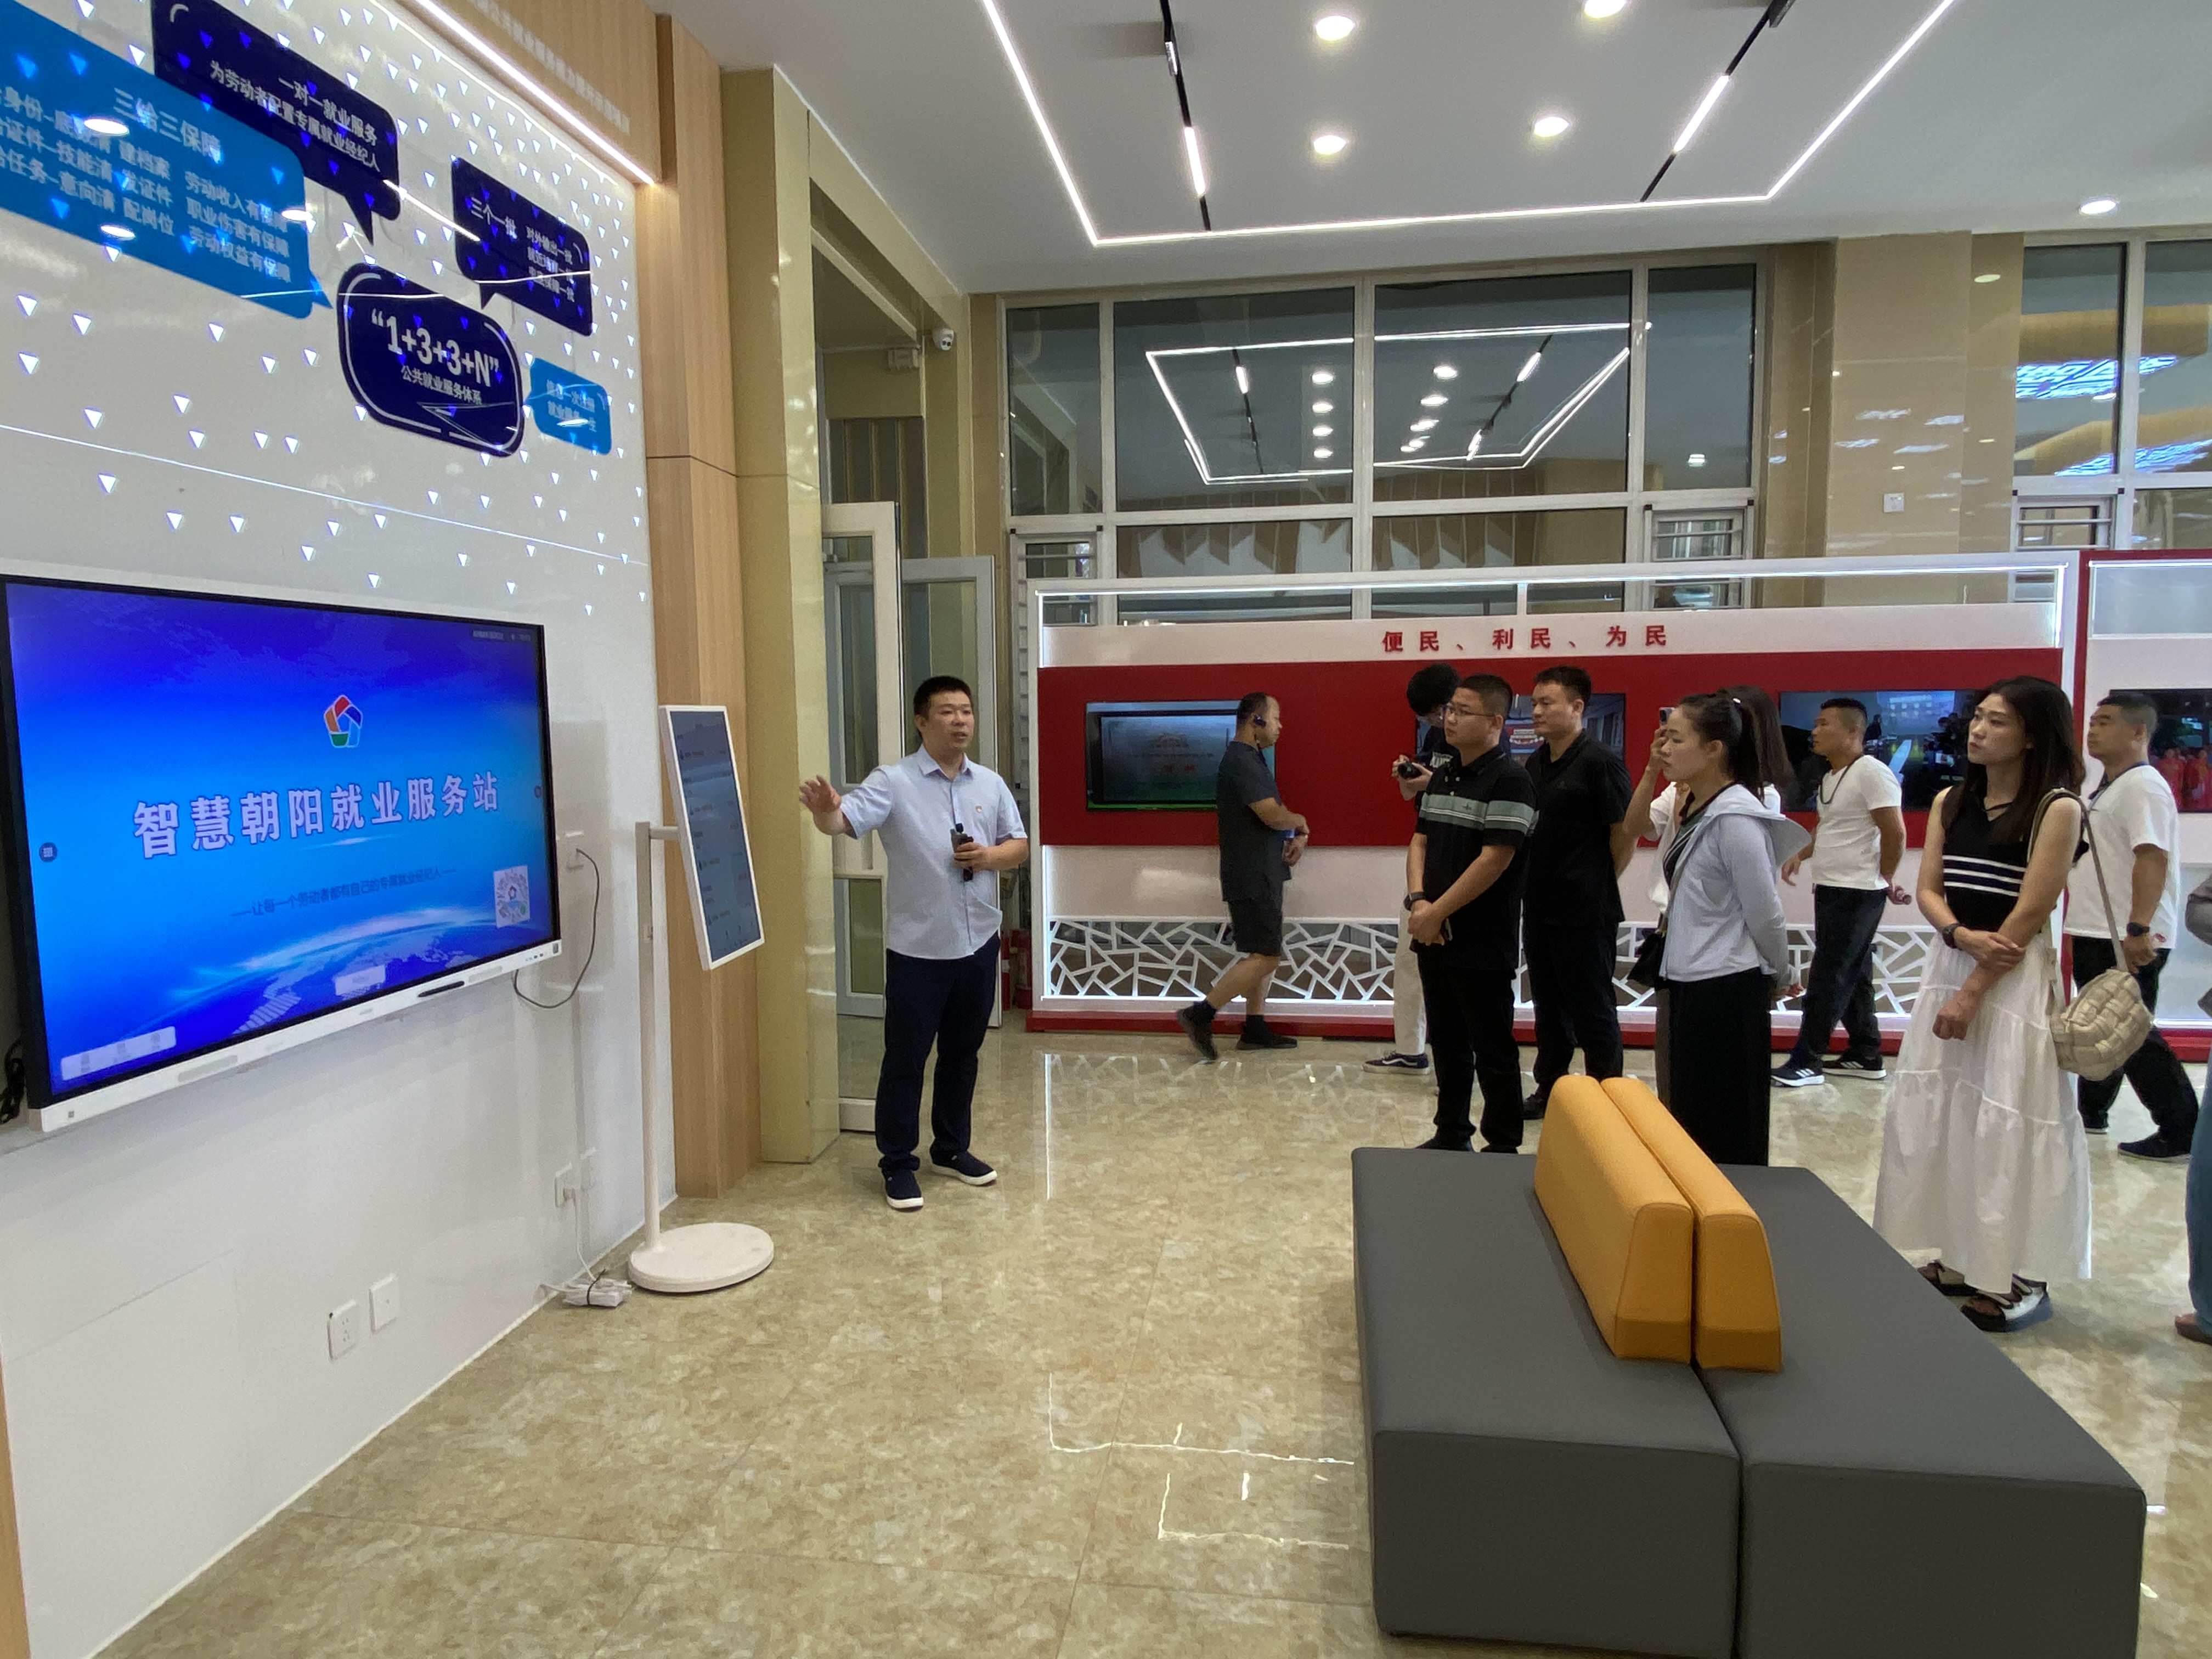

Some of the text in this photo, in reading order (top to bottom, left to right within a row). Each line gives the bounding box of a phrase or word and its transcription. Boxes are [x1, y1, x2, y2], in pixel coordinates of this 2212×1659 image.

[278, 77, 377, 146] 一对一就业服务
[401, 365, 482, 405] 公共就业服务体系
[1382, 625, 1667, 653] 便民、利民、为民
[133, 770, 498, 860] 智慧朝阳就业服务站
